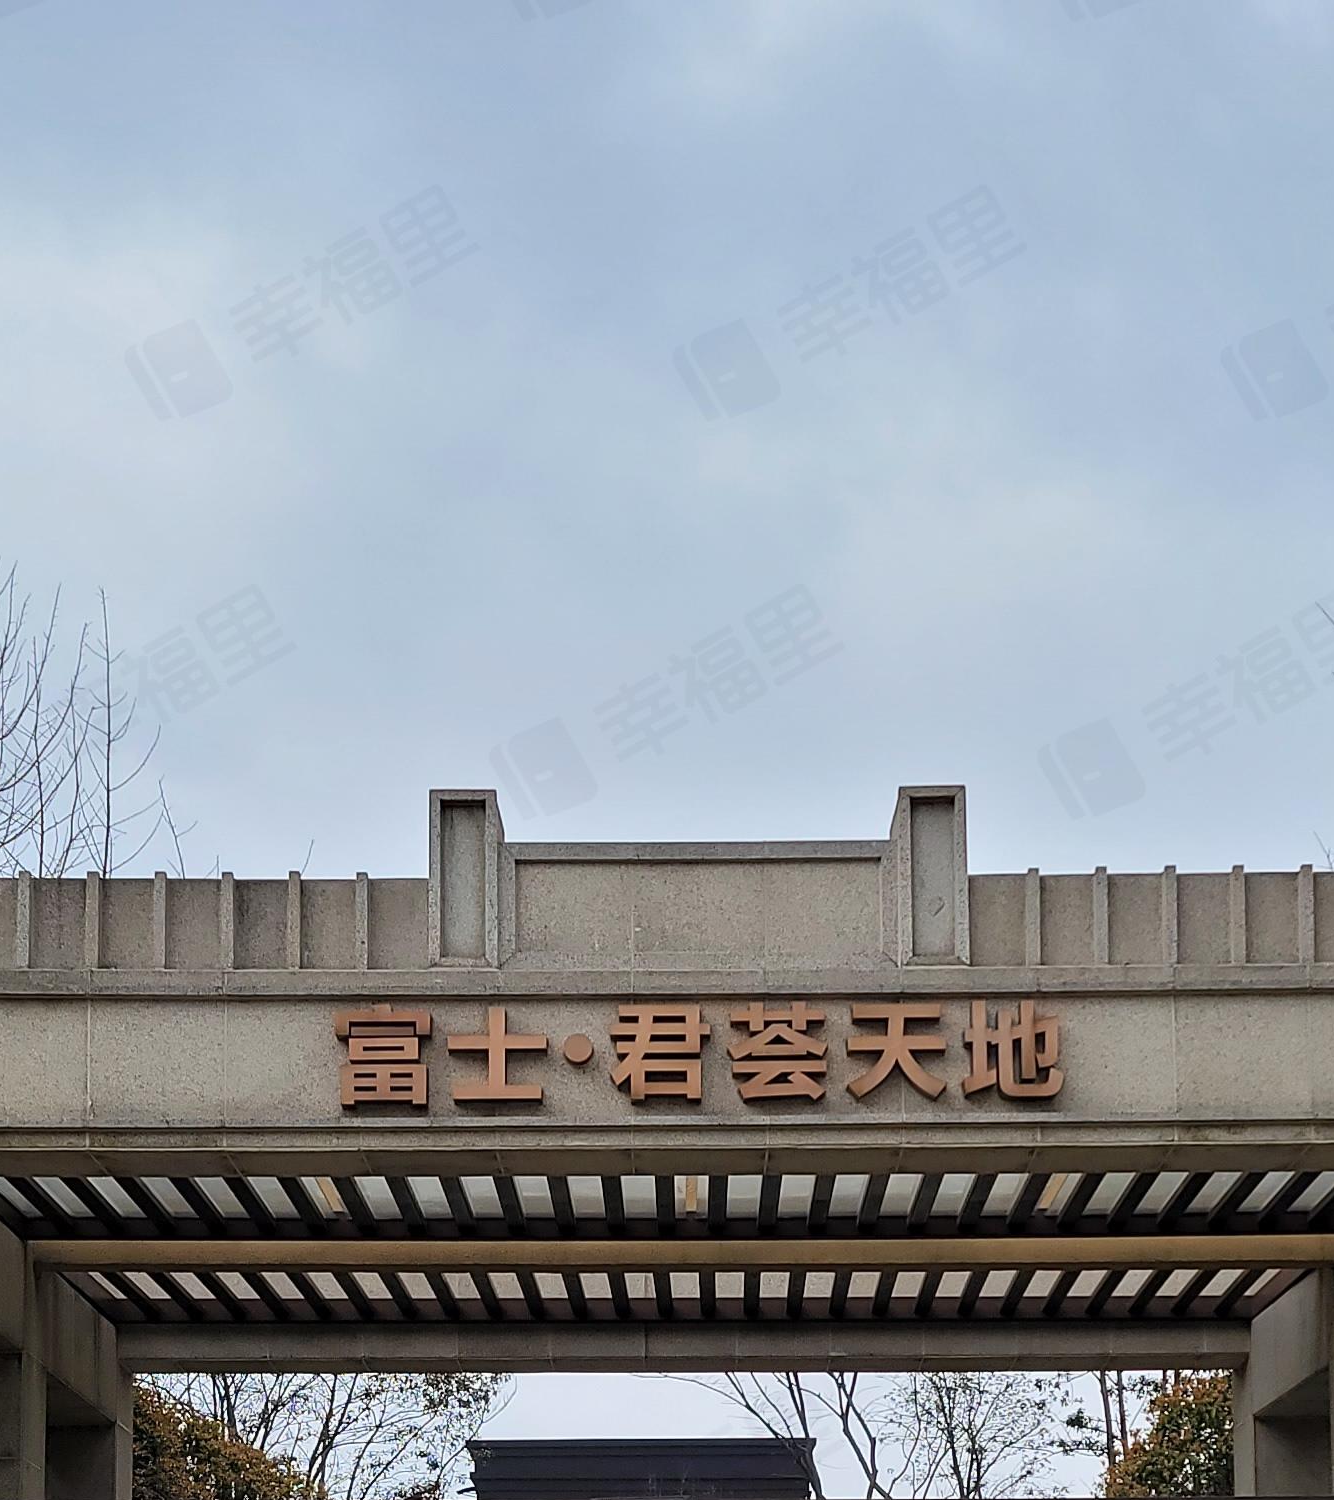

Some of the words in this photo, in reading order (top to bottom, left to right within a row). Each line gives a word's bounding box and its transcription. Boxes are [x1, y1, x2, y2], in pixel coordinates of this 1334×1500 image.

[334, 1001, 1065, 1108] 富士·君荟天地
